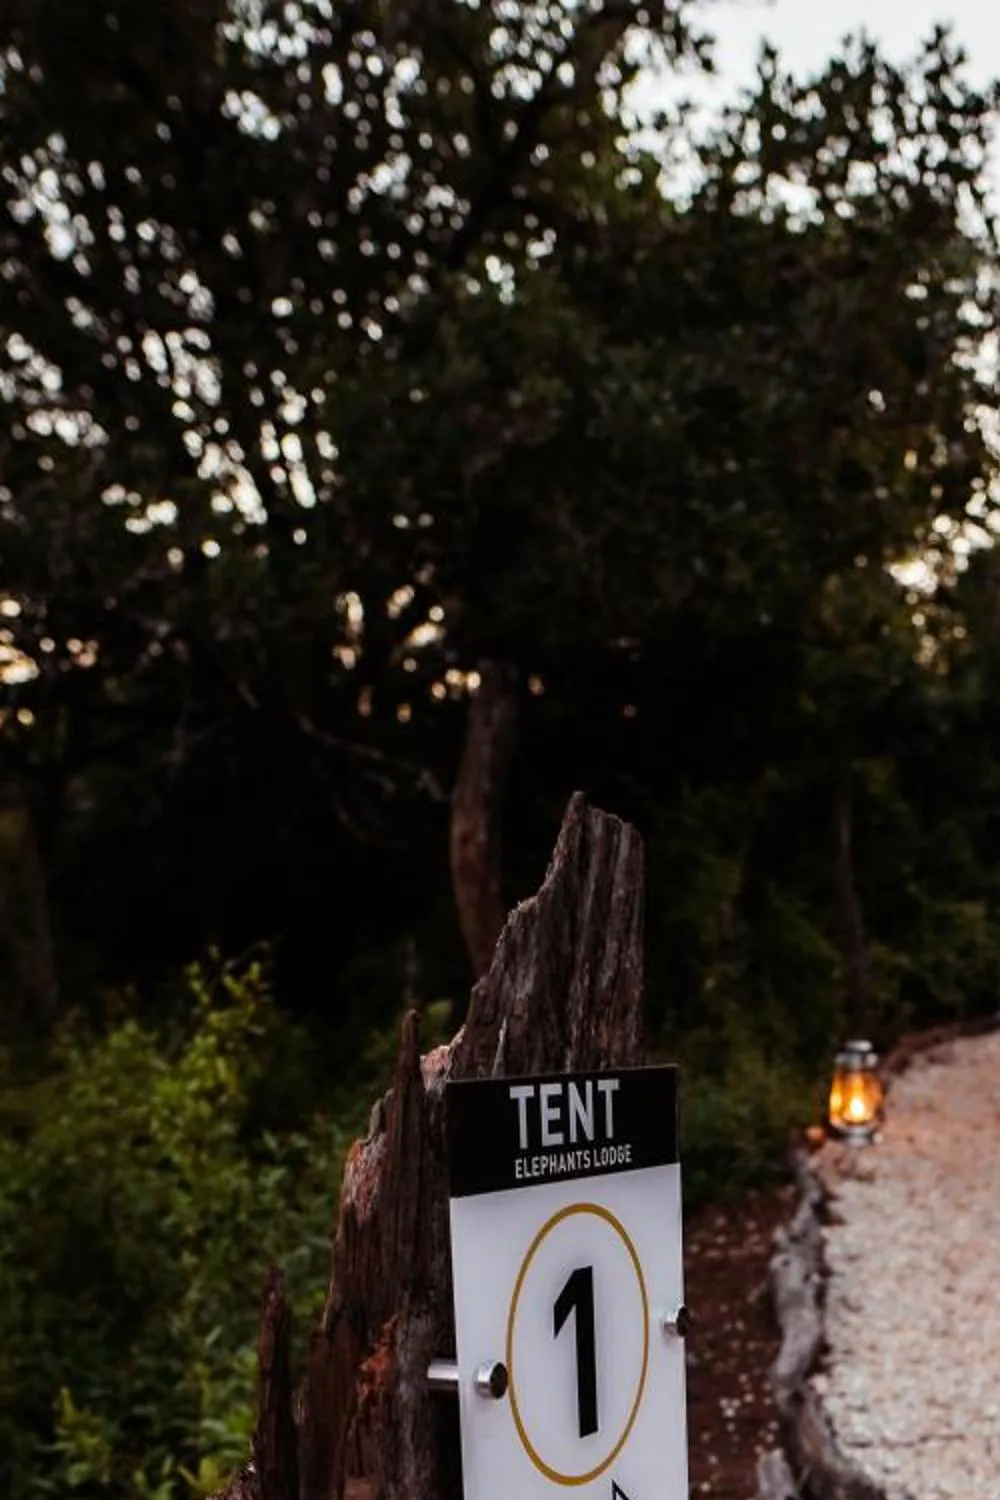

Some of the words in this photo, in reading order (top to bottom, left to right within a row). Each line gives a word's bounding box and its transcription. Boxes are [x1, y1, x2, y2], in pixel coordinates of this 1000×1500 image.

[509, 1078, 619, 1149] TENT
[514, 1149, 591, 1179] ELEPHANTS
[594, 1144, 632, 1168] LODGE
[554, 1266, 598, 1438] 1
